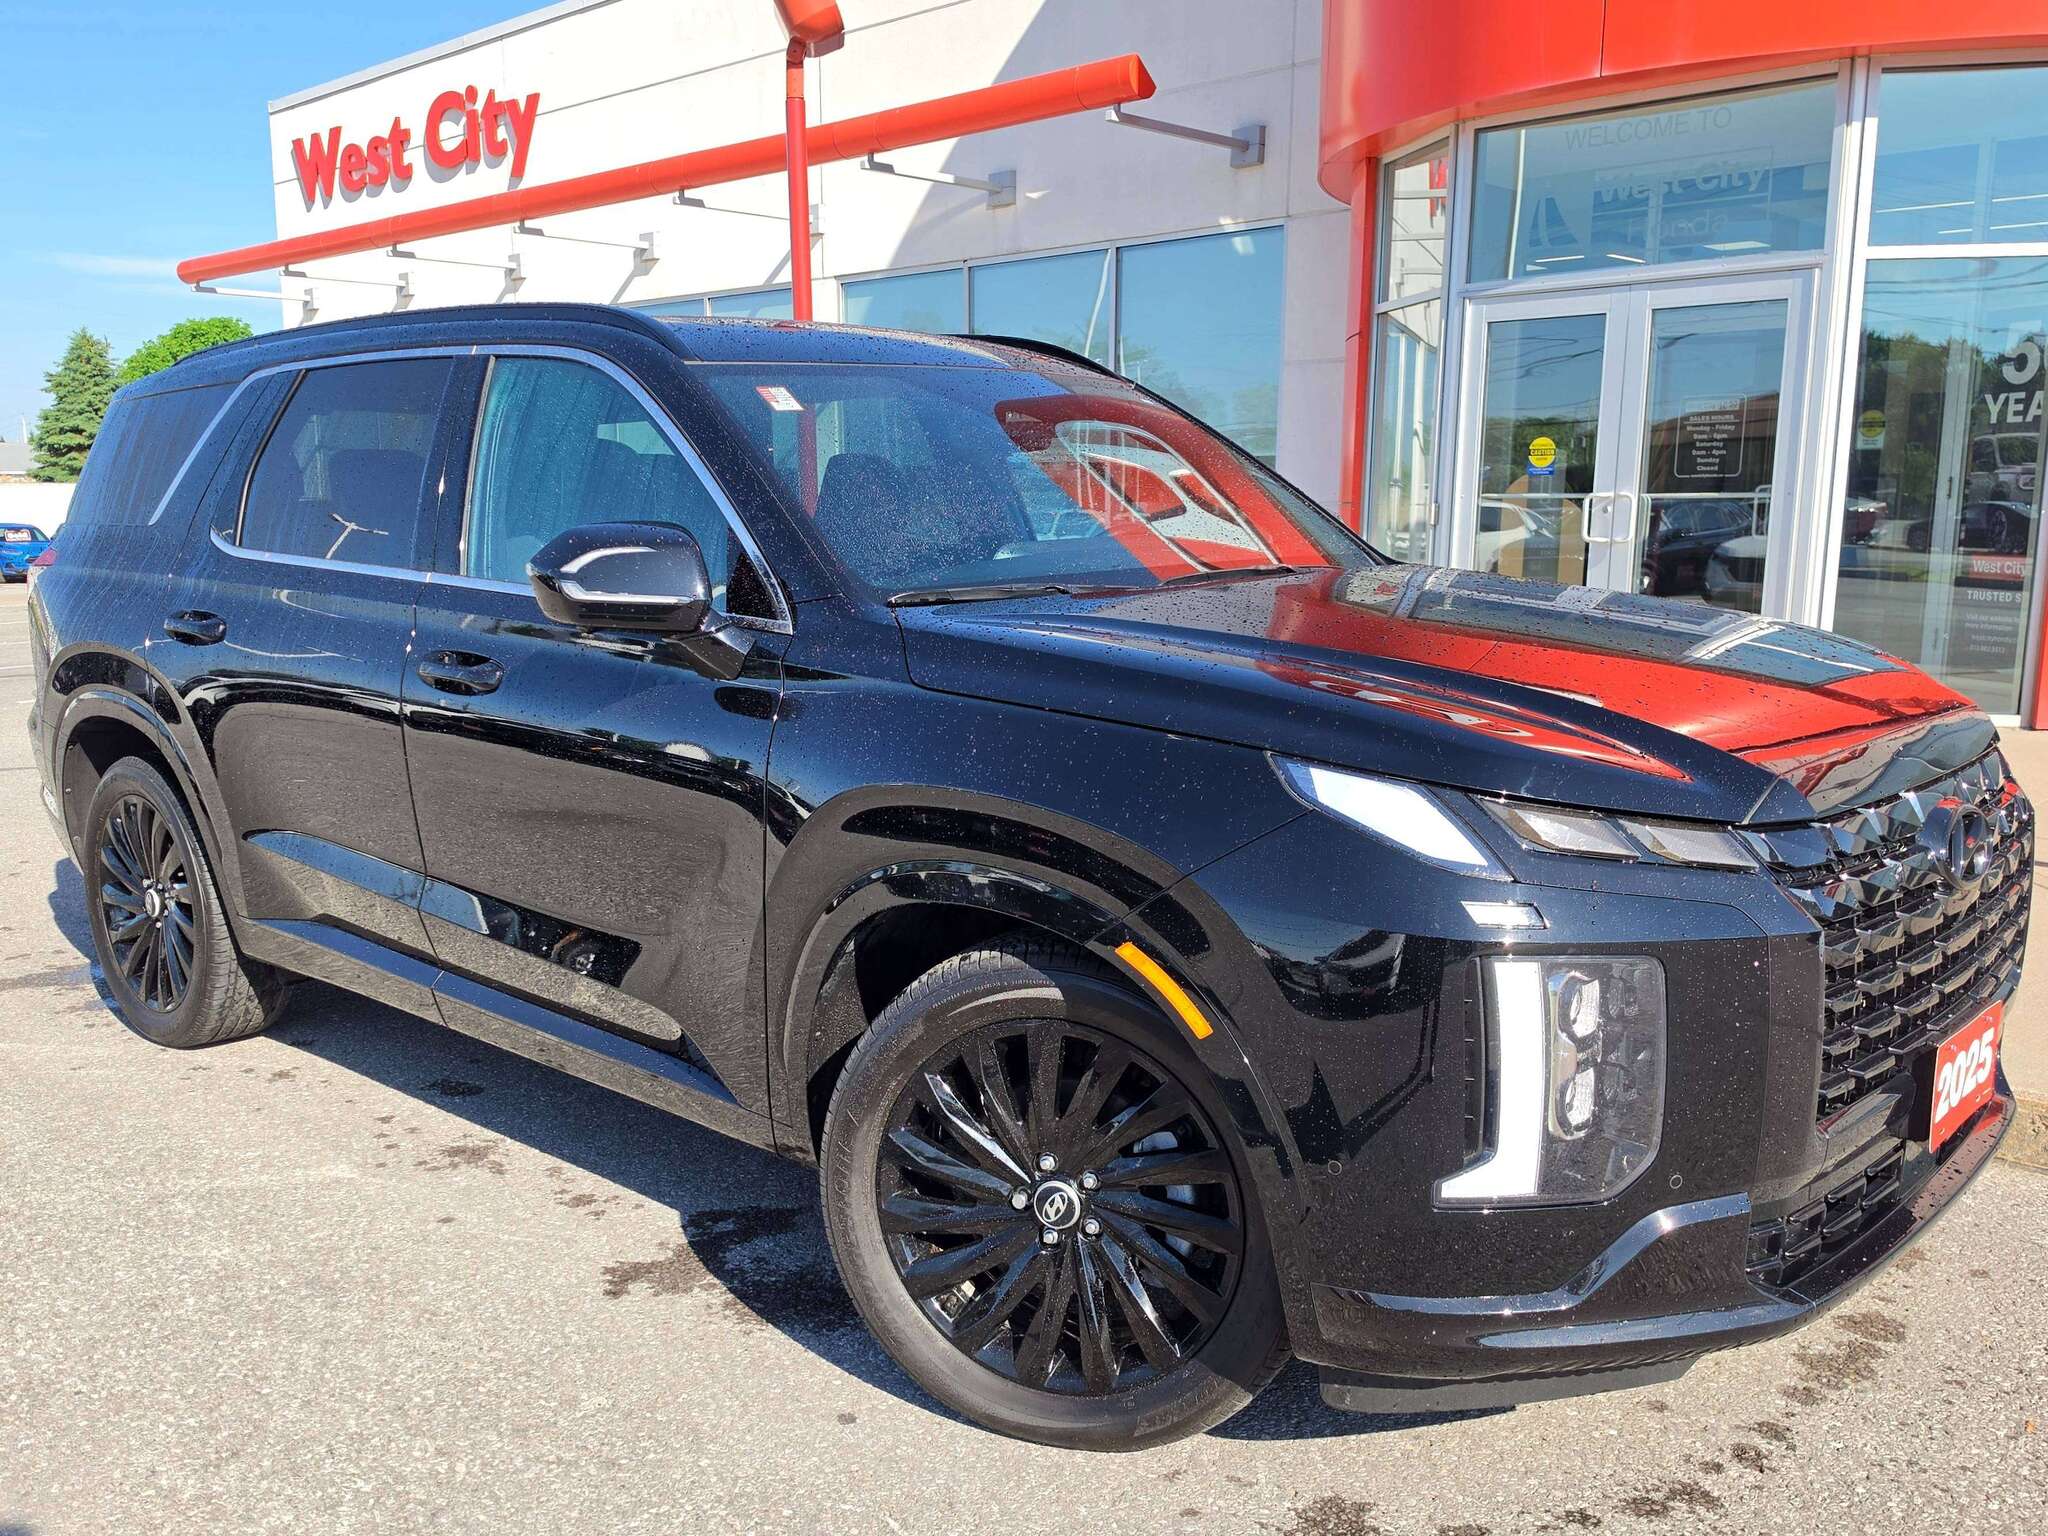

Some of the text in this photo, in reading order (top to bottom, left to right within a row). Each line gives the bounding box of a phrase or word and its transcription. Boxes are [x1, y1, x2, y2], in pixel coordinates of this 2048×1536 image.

[292, 84, 541, 204] West City
[1564, 106, 1733, 151] WELCOME TO
[1597, 160, 1766, 202] West City
[1973, 560, 2001, 574] West
[1967, 590, 2012, 602] TRUSTED
[1935, 1027, 1995, 1124] 2025
